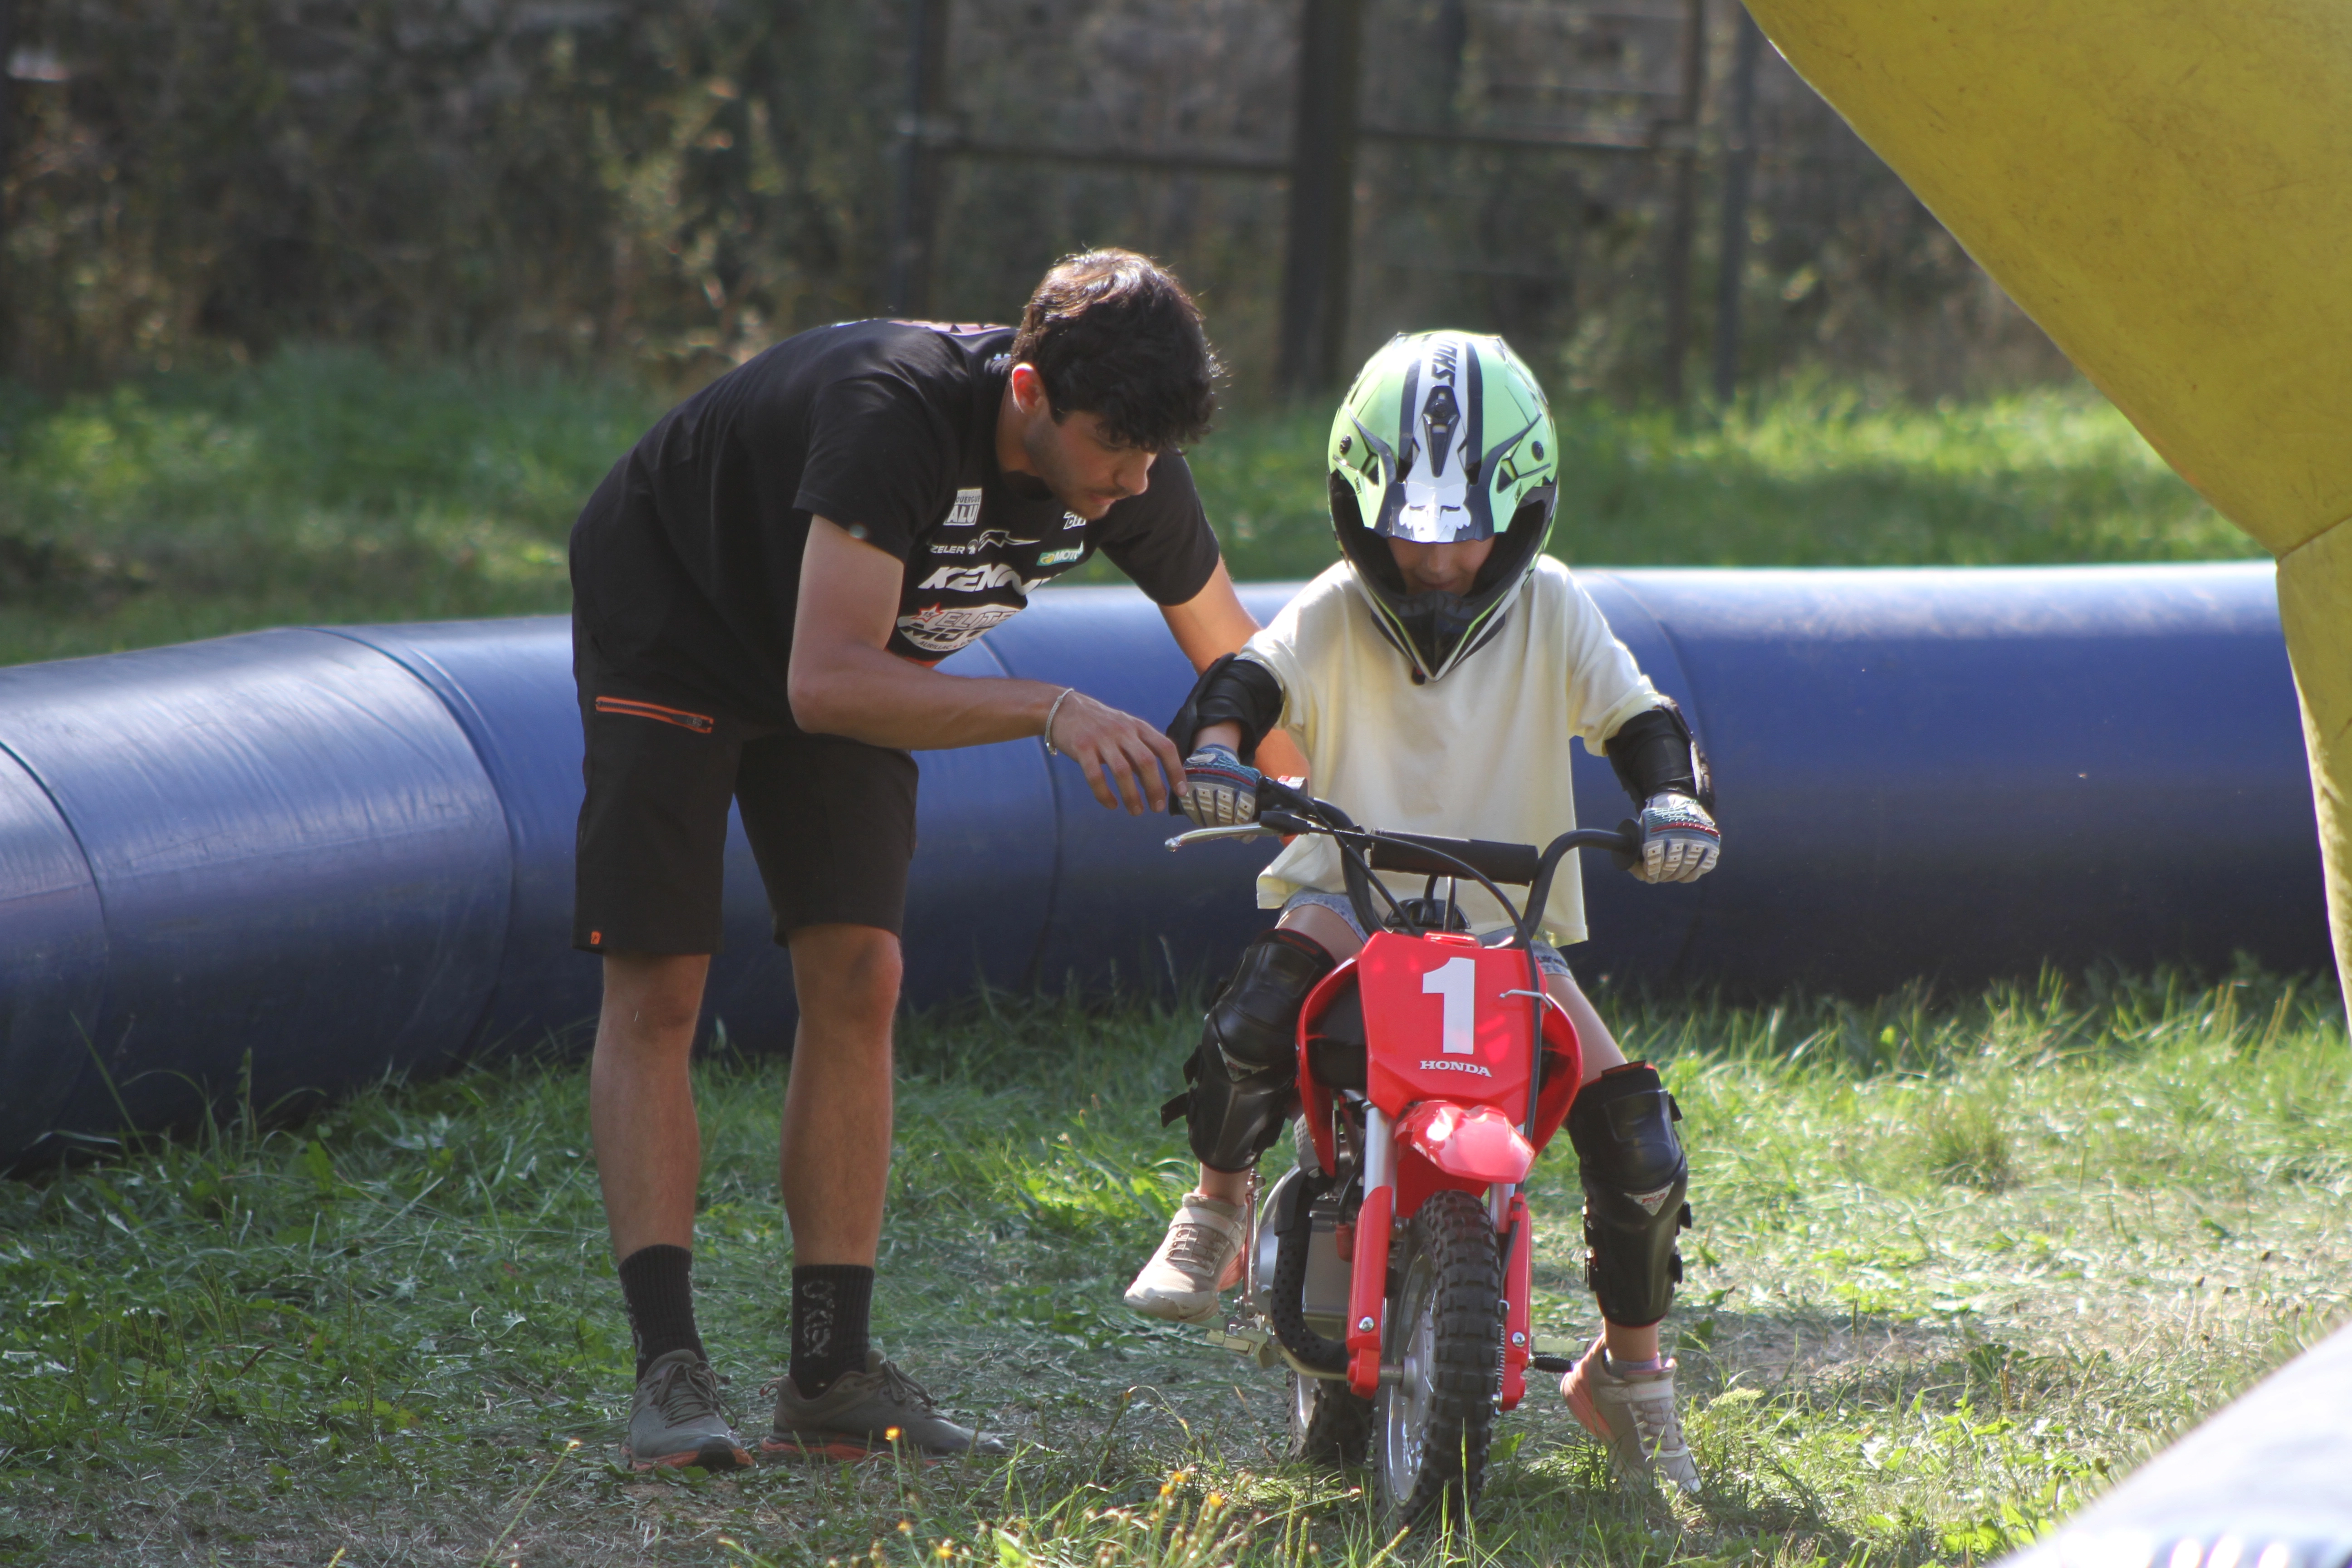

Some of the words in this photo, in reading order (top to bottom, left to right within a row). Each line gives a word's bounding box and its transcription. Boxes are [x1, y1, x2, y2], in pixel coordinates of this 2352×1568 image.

[946, 505, 979, 523] ALU
[917, 563, 1060, 596] KENN
[1422, 957, 1475, 1055] 1
[1419, 1060, 1492, 1078] HONDA
